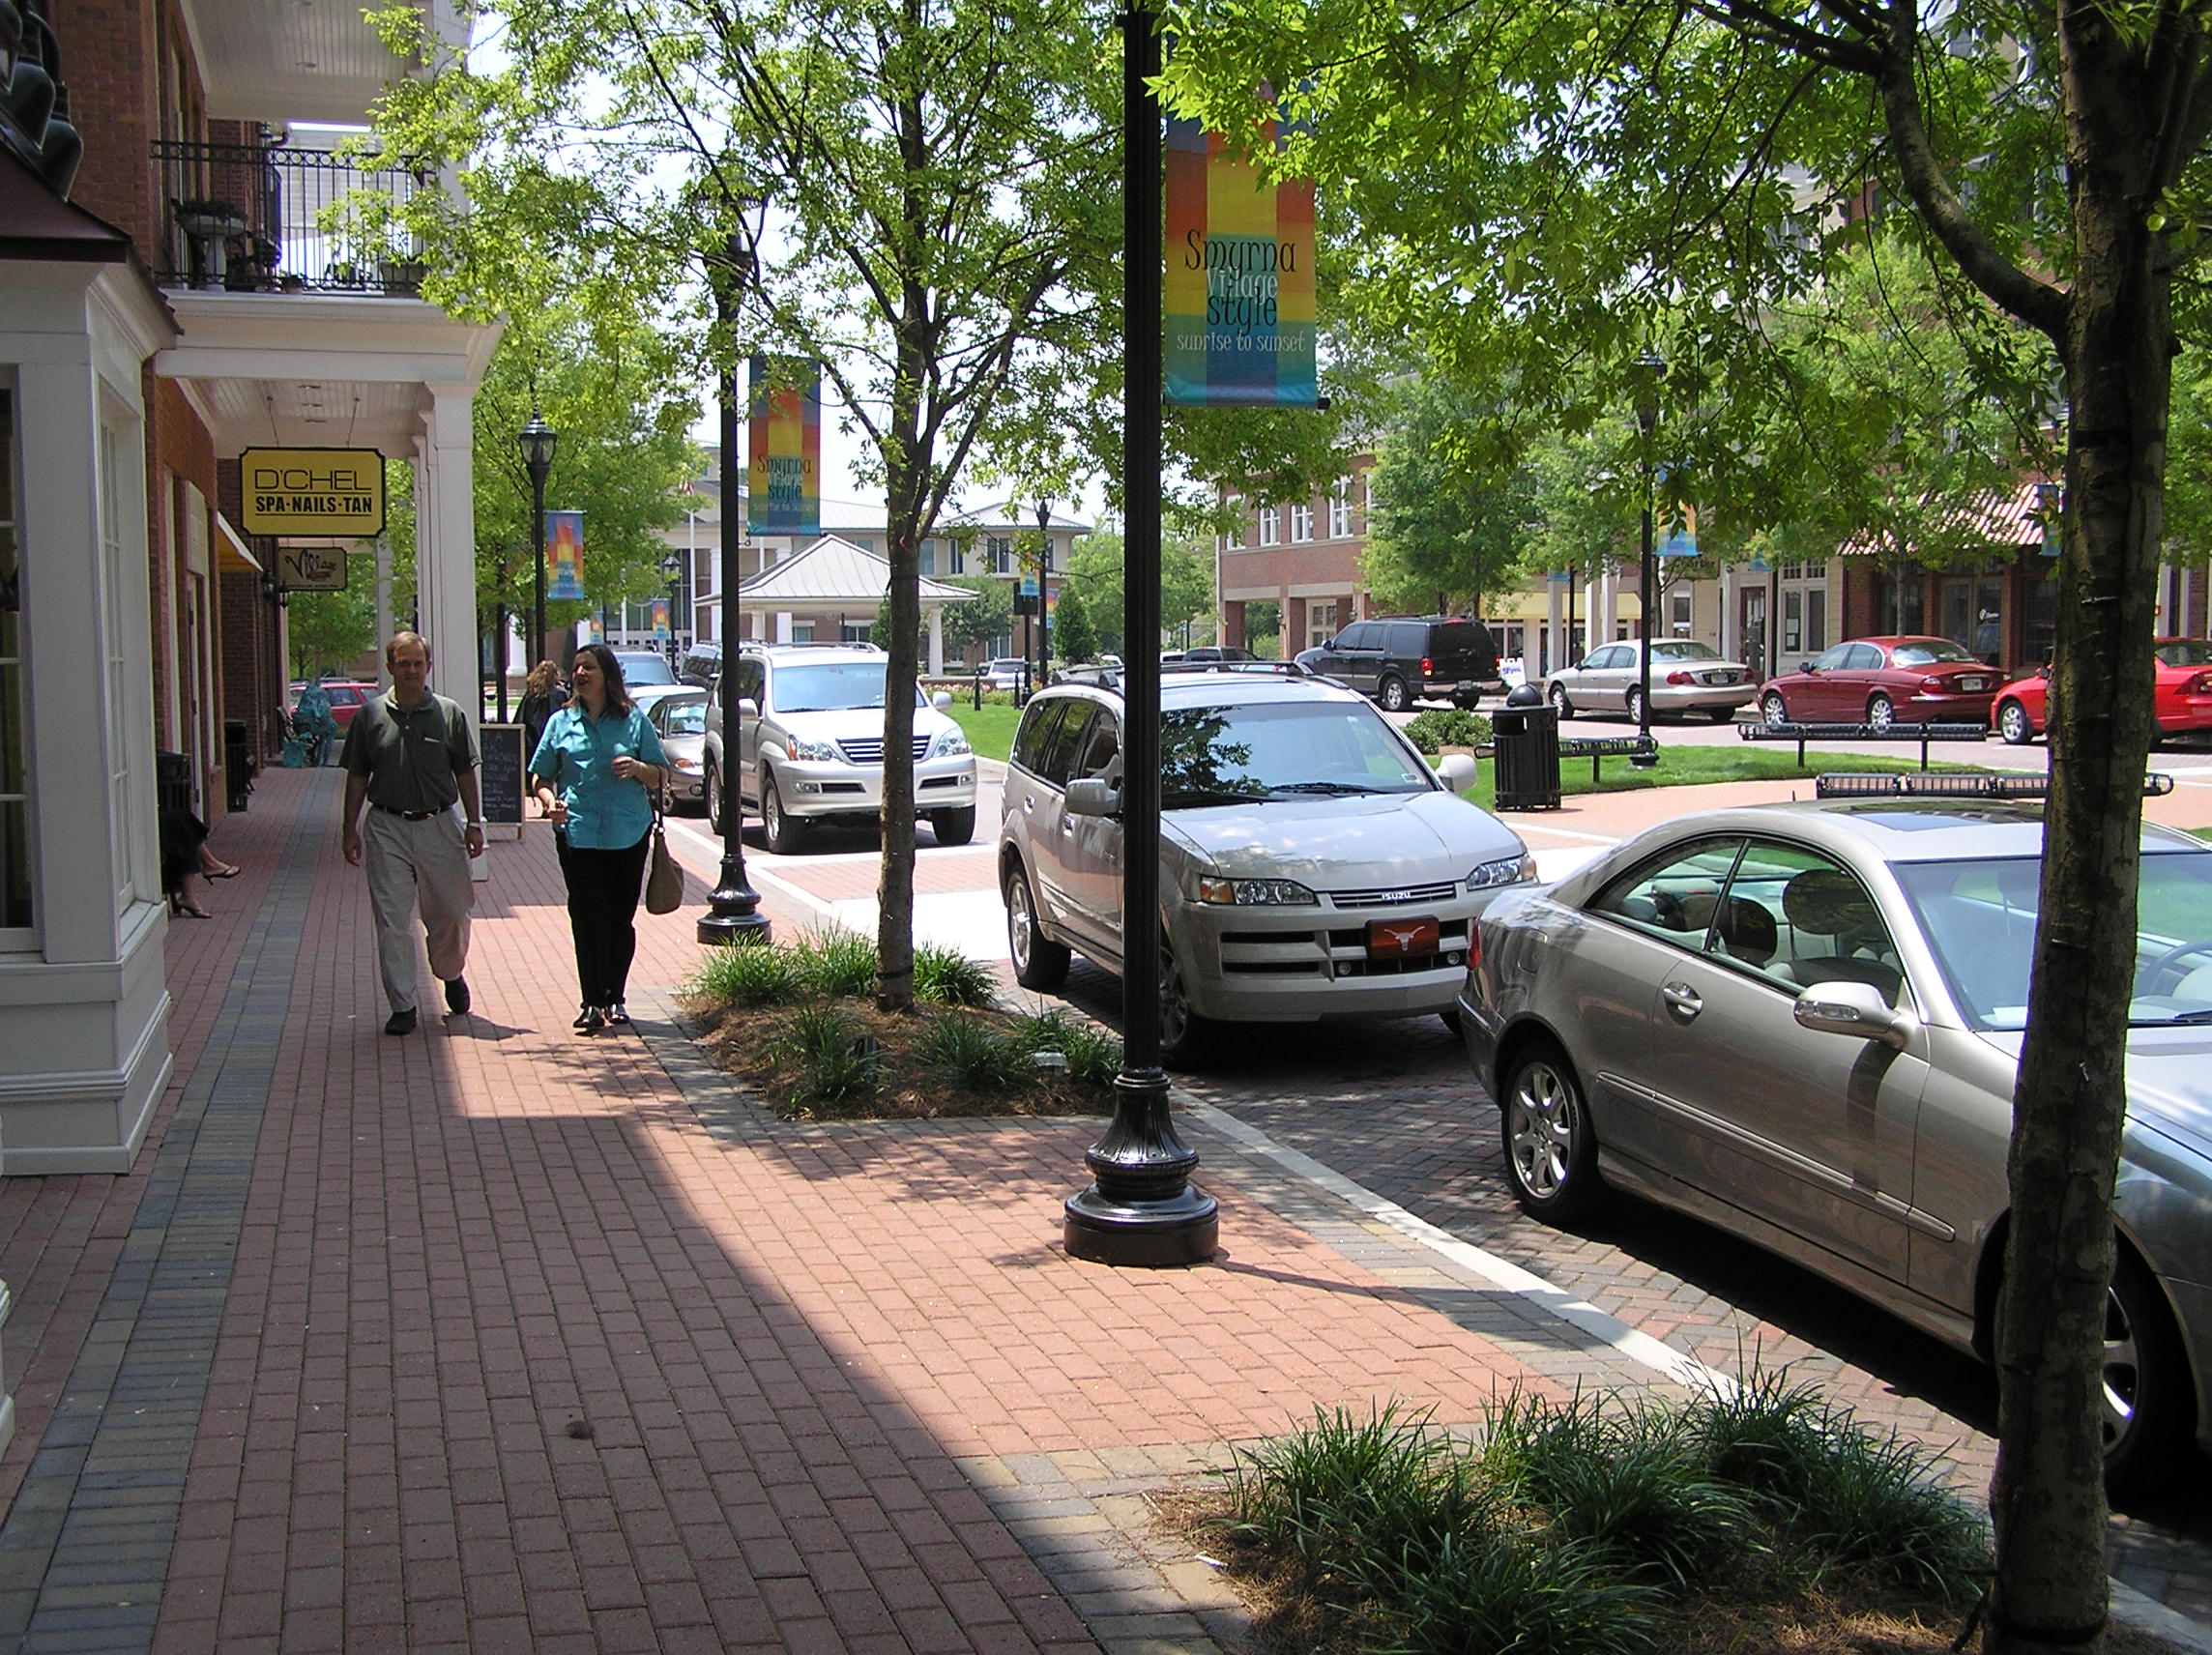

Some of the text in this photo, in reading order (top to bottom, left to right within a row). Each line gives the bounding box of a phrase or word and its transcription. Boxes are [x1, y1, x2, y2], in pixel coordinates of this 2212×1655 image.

[1185, 229, 1296, 281] Smyrna
[1207, 266, 1278, 305] Village
[1208, 285, 1277, 336] style
[1177, 330, 1306, 353] sunrise to sunset
[255, 469, 372, 491] D'CHEL
[1381, 890, 1412, 901] ISUZU
